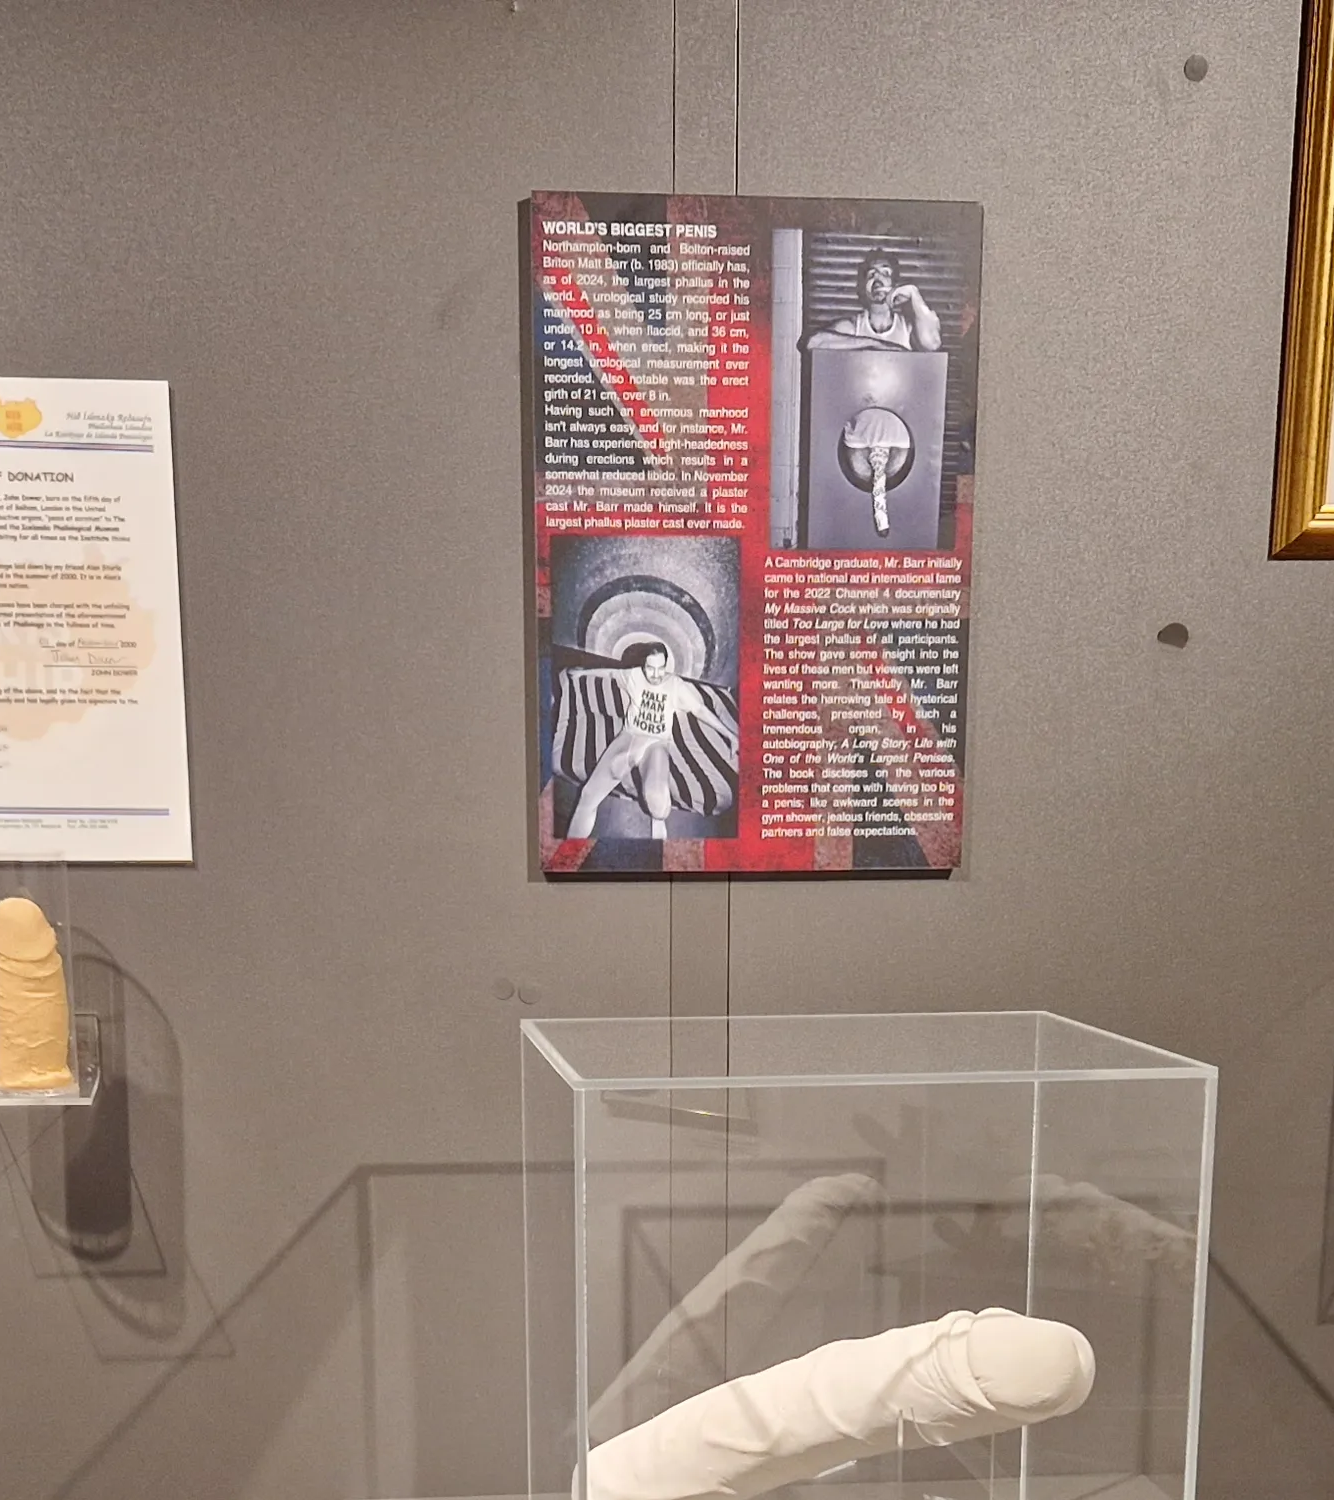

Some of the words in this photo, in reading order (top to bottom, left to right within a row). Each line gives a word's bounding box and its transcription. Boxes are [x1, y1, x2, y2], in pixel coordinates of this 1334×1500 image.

[543, 221, 607, 236] WORLD'S
[611, 222, 672, 237] BIGGEST
[676, 224, 717, 238] PENIS
[543, 240, 642, 256] Northampton-born
[649, 242, 671, 254] and
[679, 243, 751, 256] Bolton-raised
[543, 257, 575, 269] Briton
[578, 257, 601, 269] Matt
[605, 258, 629, 270] Barr
[630, 258, 645, 273] (b.
[648, 259, 679, 274] 1983)
[681, 260, 725, 275] officially
[726, 261, 750, 274] has,
[543, 356, 584, 370] longest
[589, 356, 641, 371] urological
[647, 357, 720, 369] measurement
[725, 360, 750, 369] ever
[544, 404, 582, 419] Having
[589, 405, 614, 417] such
[621, 408, 634, 417] an
[641, 408, 692, 417] enormous
[699, 406, 749, 418] manhood
[545, 420, 567, 432] isn't
[570, 420, 606, 435] always
[610, 424, 635, 435] easy
[639, 421, 659, 433] and
[663, 421, 677, 433] for
[680, 422, 727, 435] instance,
[731, 422, 748, 434] Mr.
[545, 436, 569, 448] Barr
[570, 436, 590, 448] has
[592, 437, 657, 451] experienced
[658, 437, 748, 452] light-headedness
[544, 452, 579, 467] during
[586, 453, 635, 465] erections
[642, 453, 674, 465] which
[680, 454, 716, 465] results
[723, 454, 734, 466] in
[740, 457, 748, 466] a
[8, 471, 75, 483] DONATION
[545, 468, 599, 480] somewhat
[602, 469, 645, 480] reduced
[693, 469, 749, 481] November
[546, 516, 582, 530] largest
[584, 516, 622, 531] phallus
[624, 516, 660, 531] plaster
[662, 517, 684, 528] cast
[687, 520, 711, 528] ever
[713, 517, 745, 529] made.
[764, 557, 774, 569] A
[775, 557, 831, 571] Cambridge
[833, 557, 882, 571] graduate,
[884, 557, 901, 569] Mr.
[903, 557, 926, 569] Barr
[927, 557, 963, 571] initially
[764, 575, 793, 583] came
[795, 572, 806, 583] to
[807, 572, 848, 583] national
[849, 572, 870, 583] and
[871, 572, 934, 584] international
[935, 573, 961, 584] fame
[764, 587, 780, 598] for
[783, 587, 800, 598] the
[804, 587, 831, 598] 2022
[835, 587, 879, 598] Channel
[884, 587, 892, 598] 4
[895, 587, 962, 601] documentary
[764, 633, 780, 644] the
[785, 633, 820, 647] largest
[825, 633, 861, 647] phallus
[866, 633, 877, 644] of
[882, 633, 893, 644] all
[898, 633, 959, 646] participants.
[763, 678, 803, 692] wanting
[850, 678, 902, 692] Thankfully
[911, 678, 928, 689] Mr.
[936, 678, 959, 689] Barr
[641, 689, 667, 702] HALF
[641, 699, 665, 712] MAN
[638, 709, 665, 724] HALF
[831, 708, 882, 722] presented
[892, 708, 905, 722] by
[916, 708, 940, 719] such
[950, 710, 956, 719] a
[633, 715, 667, 734] HORSE
[761, 826, 803, 840] partners
[805, 826, 825, 837] and
[827, 825, 851, 837] false
[853, 825, 919, 839] expectations.
